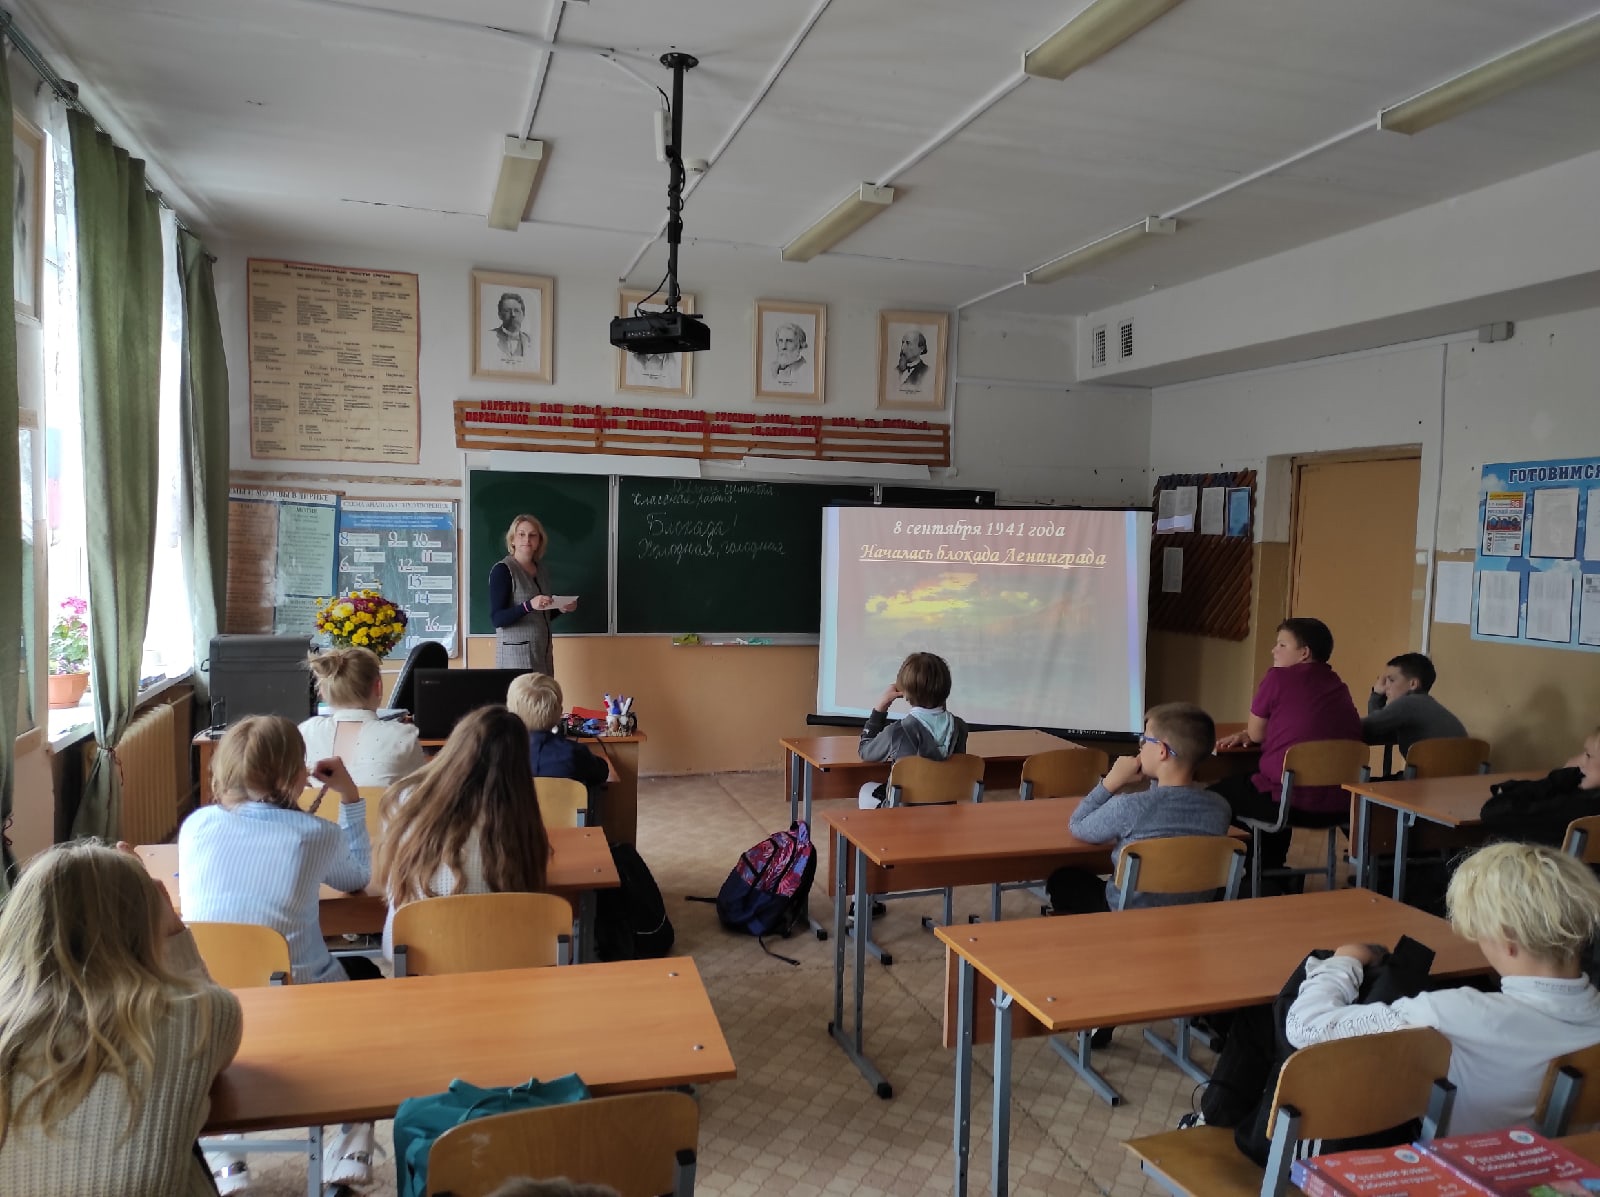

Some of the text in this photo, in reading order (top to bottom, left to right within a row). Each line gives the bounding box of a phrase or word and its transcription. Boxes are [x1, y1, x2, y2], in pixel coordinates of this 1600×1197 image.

[538, 415, 562, 426] НАМ
[893, 519, 1067, 541] 8 сентября 1941 года
[413, 532, 428, 546] 10
[860, 544, 1107, 570] Началась блокада Ленинграда
[425, 616, 440, 631] 16
